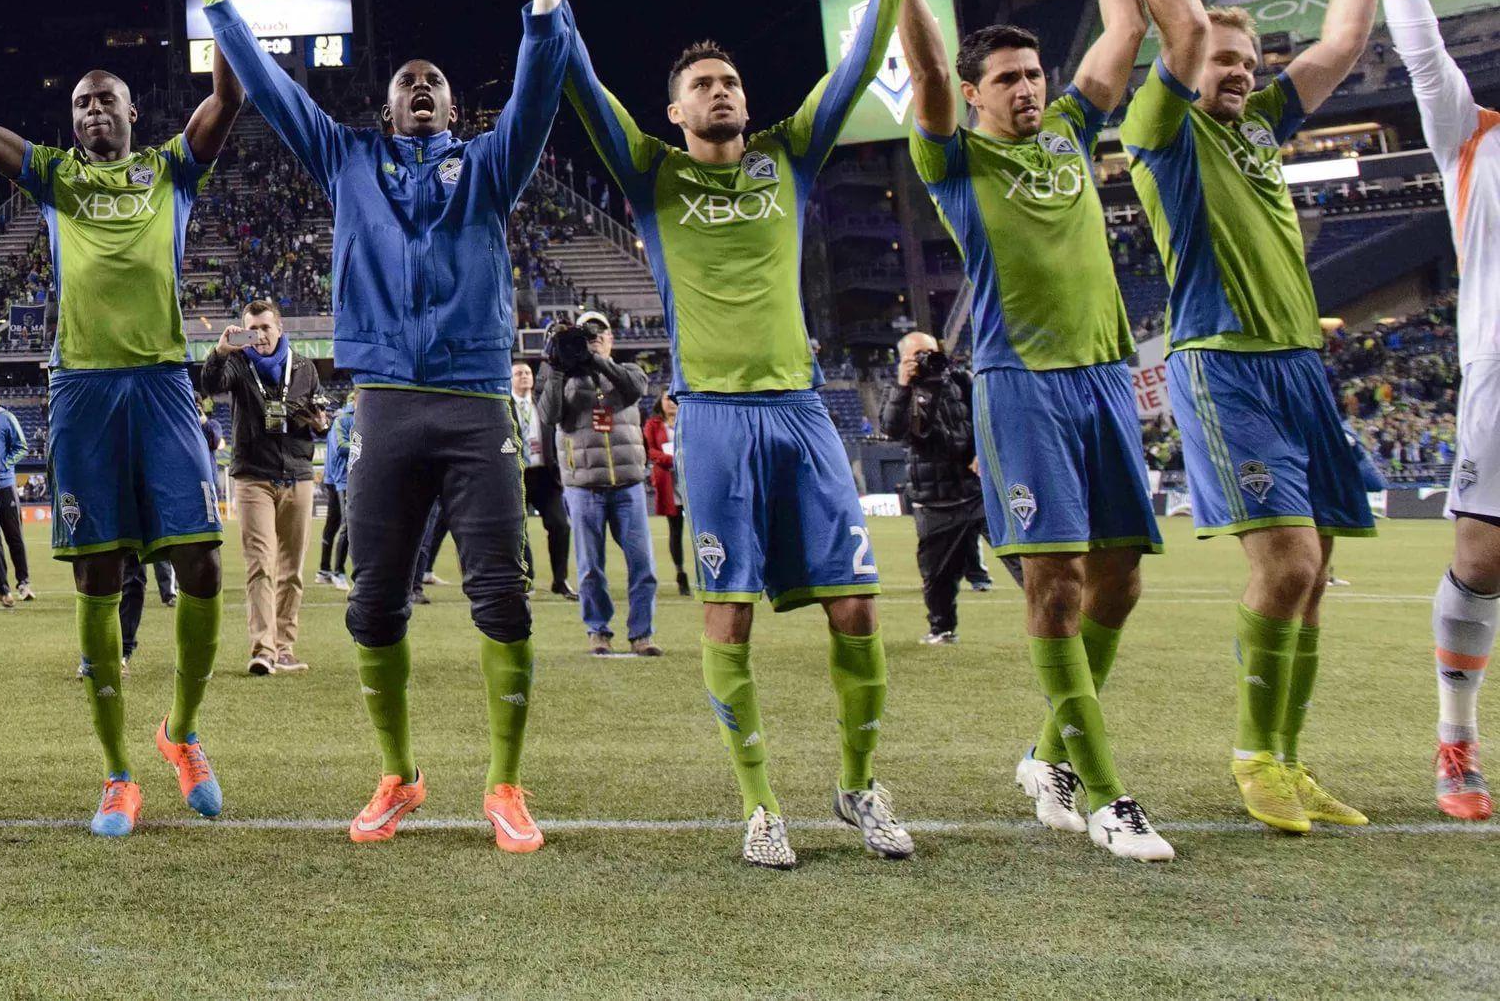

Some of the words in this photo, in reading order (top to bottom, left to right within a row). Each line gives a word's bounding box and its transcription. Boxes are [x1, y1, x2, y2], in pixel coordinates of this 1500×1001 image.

[72, 188, 156, 219] XBOX
[679, 183, 787, 224] XBOX
[849, 525, 877, 574] 2
